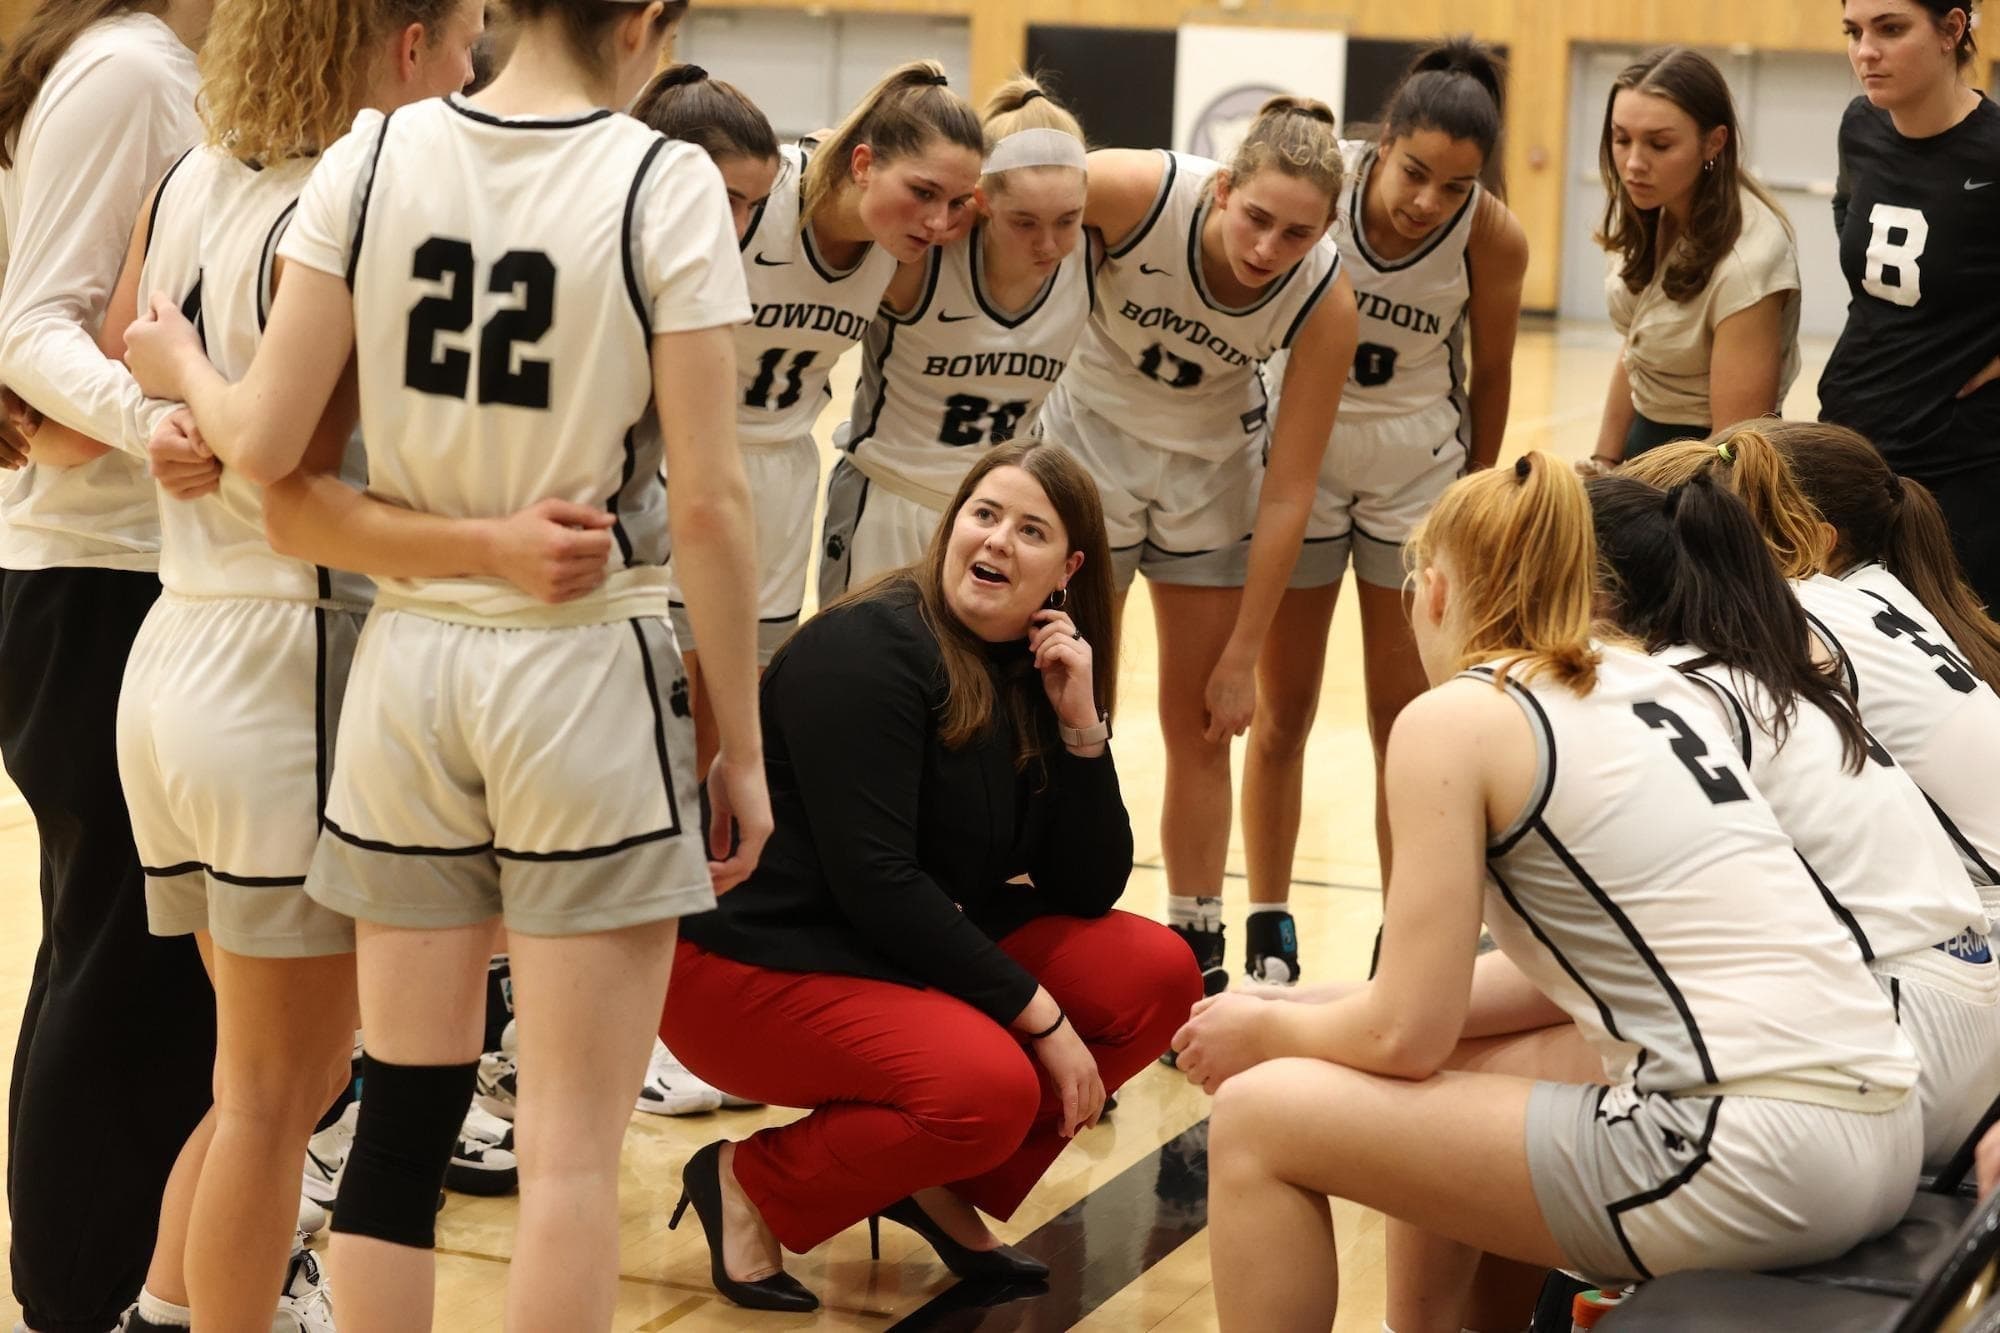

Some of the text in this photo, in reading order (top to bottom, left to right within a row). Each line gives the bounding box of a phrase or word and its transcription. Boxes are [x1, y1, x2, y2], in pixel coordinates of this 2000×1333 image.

[1861, 203, 1929, 307] B
[404, 236, 557, 410] 22
[751, 303, 869, 341] OWDOI
[1119, 300, 1252, 366] BOWDOIN
[1354, 289, 1440, 335] WDOIN
[745, 348, 819, 408] 11
[1632, 701, 1750, 805] 2
